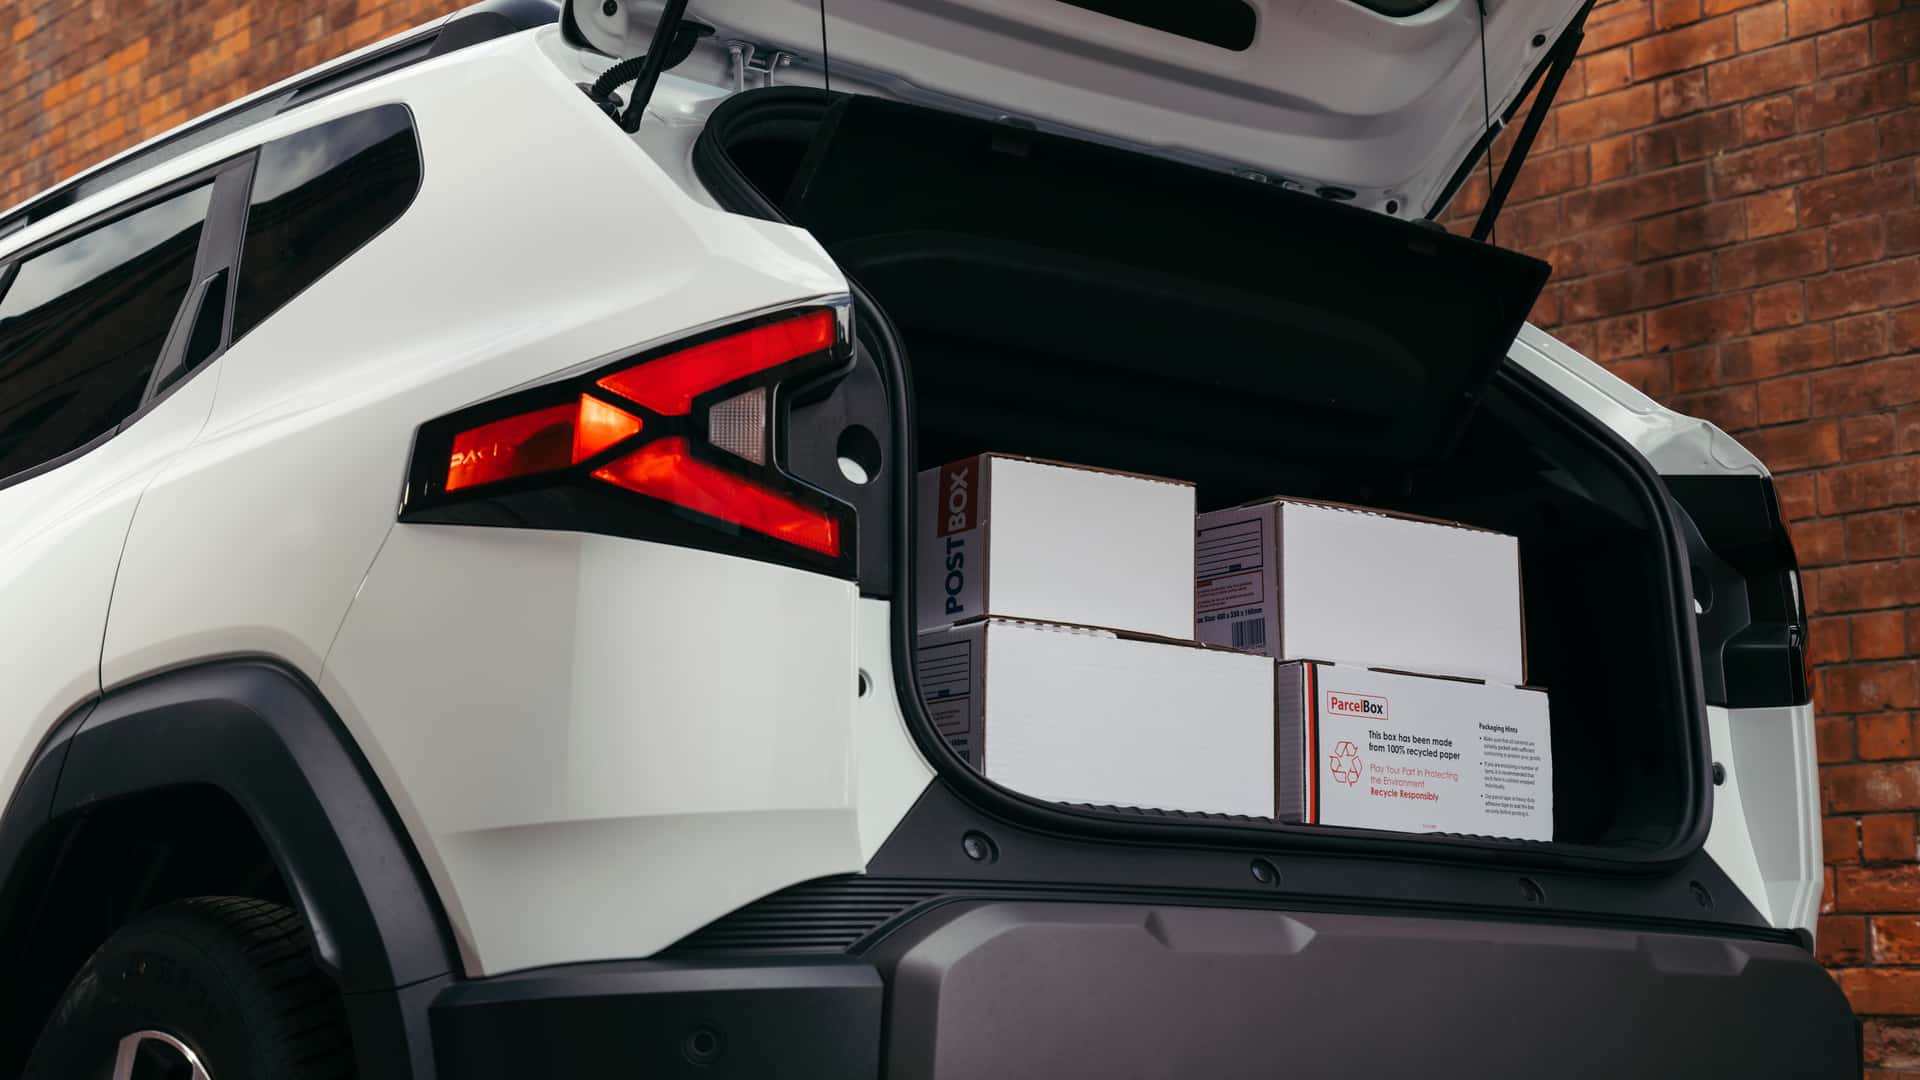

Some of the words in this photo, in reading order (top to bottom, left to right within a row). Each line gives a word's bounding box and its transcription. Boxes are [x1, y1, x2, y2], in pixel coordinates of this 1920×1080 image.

[948, 467, 969, 533] BOX
[945, 537, 964, 615] POST
[1331, 696, 1383, 715] ParcelBox
[1479, 722, 1504, 734] Packaging
[1505, 725, 1518, 734] Hints
[1368, 730, 1381, 740] This
[1383, 731, 1396, 741] box
[1398, 733, 1411, 743] has
[1412, 735, 1430, 745] been
[1432, 738, 1453, 747] made
[1368, 742, 1385, 753] from
[1387, 744, 1405, 755] 100%
[1406, 748, 1438, 758] recycled
[1440, 751, 1460, 760] paper
[1370, 763, 1384, 774] Play
[1386, 765, 1400, 775] Your
[1402, 767, 1415, 776] Part
[1416, 768, 1423, 777] in
[1424, 768, 1458, 782] Protecting
[1370, 776, 1381, 785] the
[1384, 777, 1425, 788] Environment
[1370, 787, 1397, 798] Recycle
[1400, 789, 1439, 803] Responsibly
